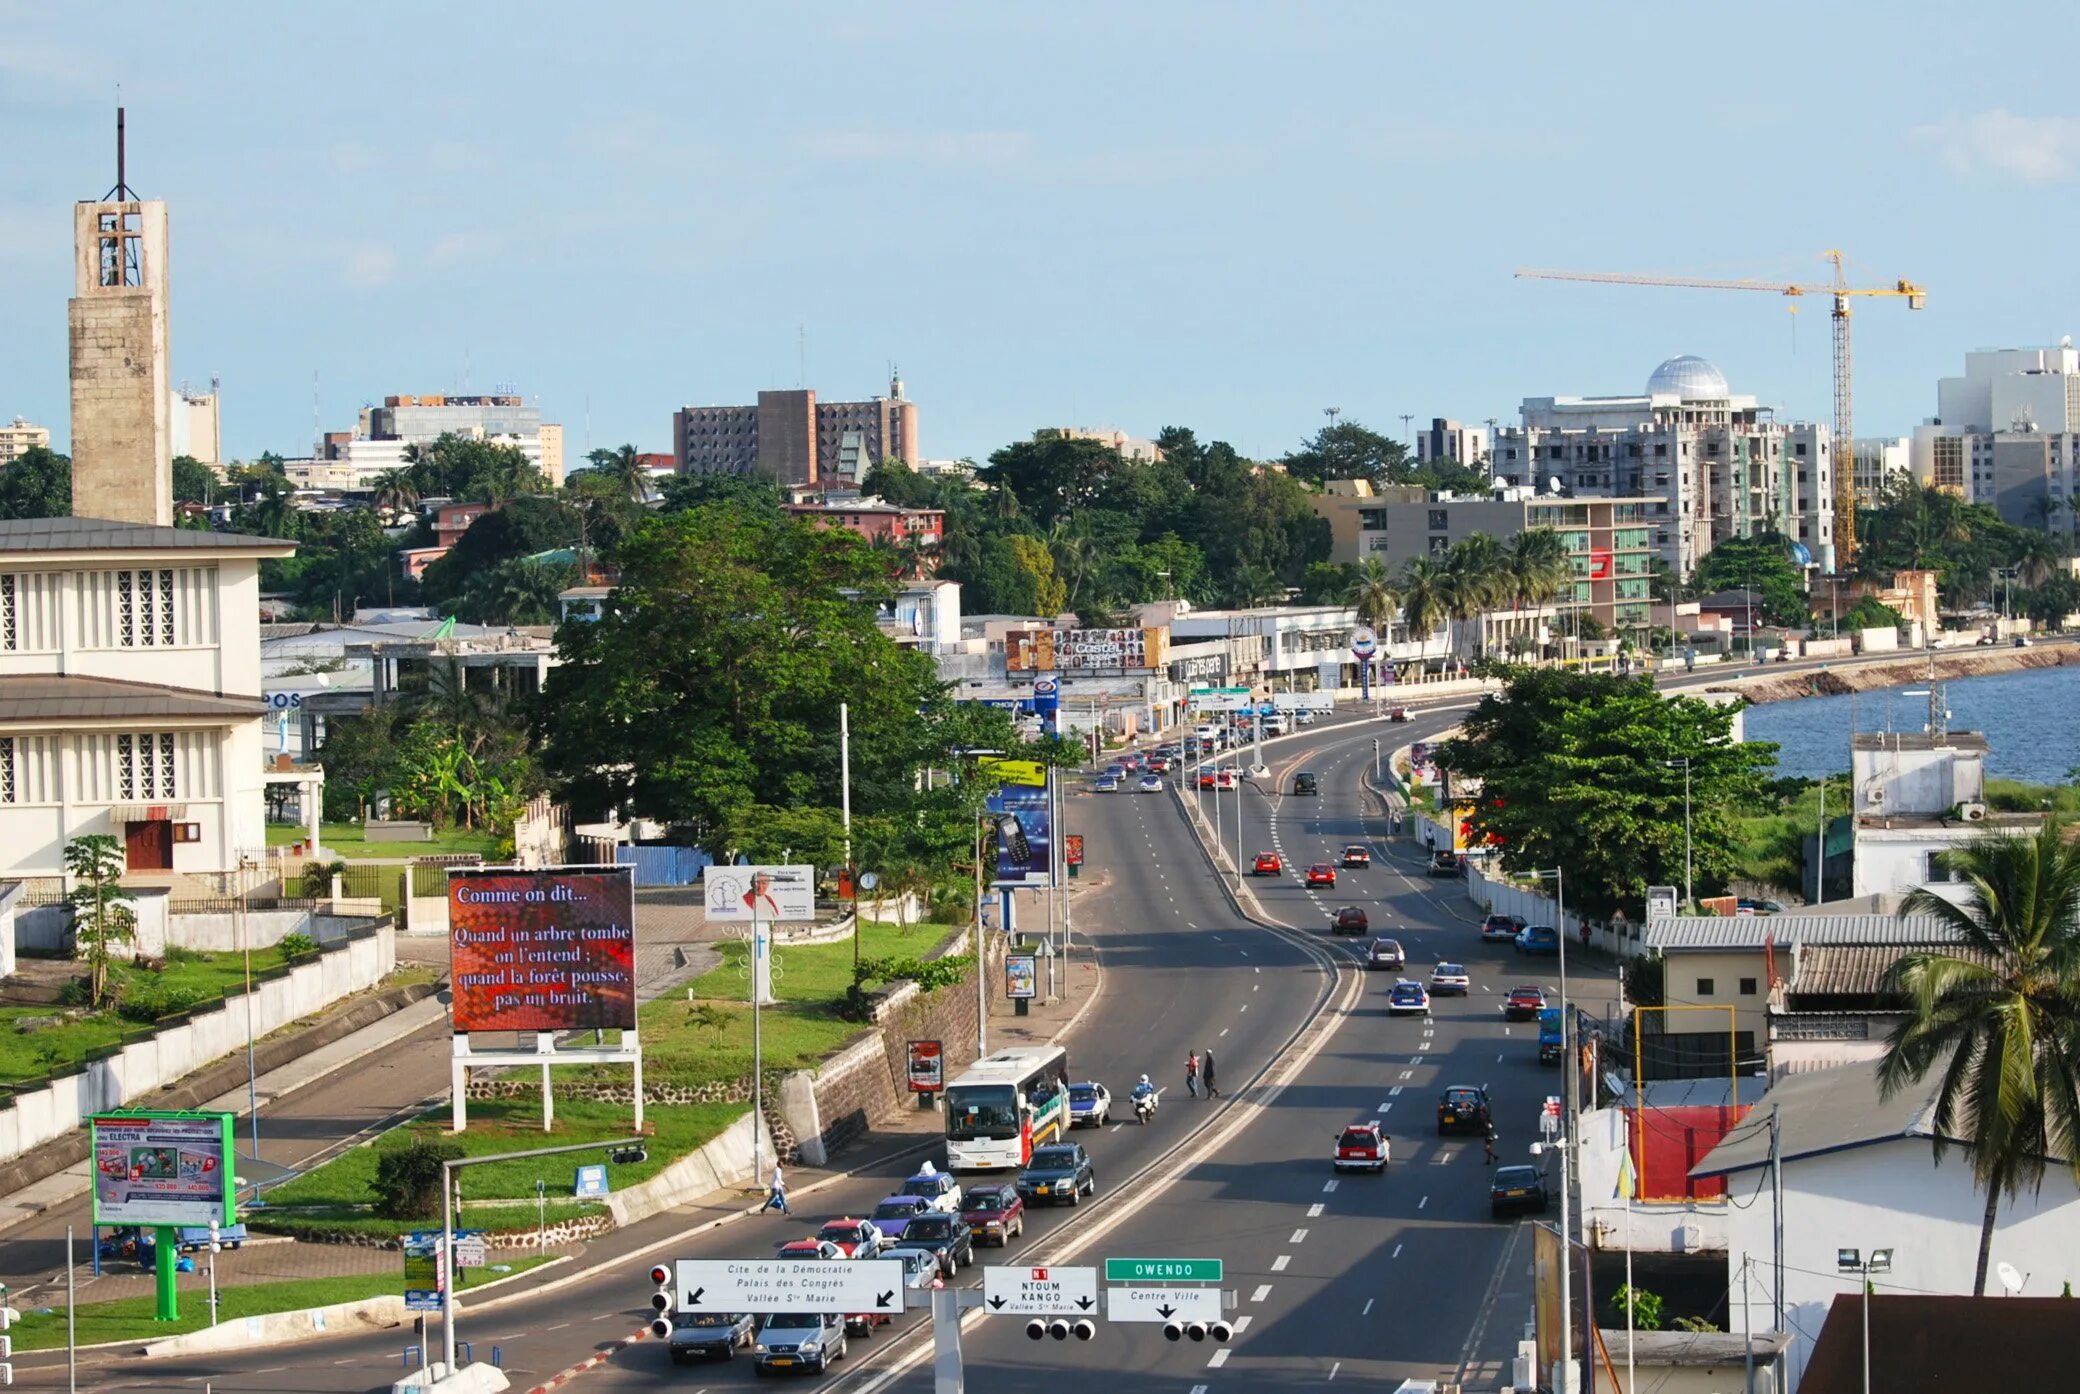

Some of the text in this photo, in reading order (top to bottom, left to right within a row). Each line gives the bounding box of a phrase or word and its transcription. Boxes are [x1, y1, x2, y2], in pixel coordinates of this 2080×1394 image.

[457, 885, 588, 904] Comme on dit...
[454, 924, 630, 948] Quand un arbre tombe
[494, 950, 514, 964] on
[520, 946, 580, 964] l'entend
[458, 969, 628, 990] quand la forêt pousse,
[494, 990, 593, 1010] pas un bruit.
[110, 1133, 140, 1141] ELECTRA
[757, 1265, 769, 1274] de
[776, 1265, 786, 1274] la
[792, 1265, 853, 1274] Démocratie
[1135, 1264, 1192, 1276] OWENDO
[737, 1278, 769, 1288] Palais
[776, 1278, 794, 1288] des
[1022, 1282, 1060, 1291] NTOUM
[747, 1294, 779, 1303] Vallée
[806, 1294, 836, 1303] Marie
[1022, 1293, 1060, 1302] KANGO
[1130, 1291, 1200, 1301] Centre Ville
